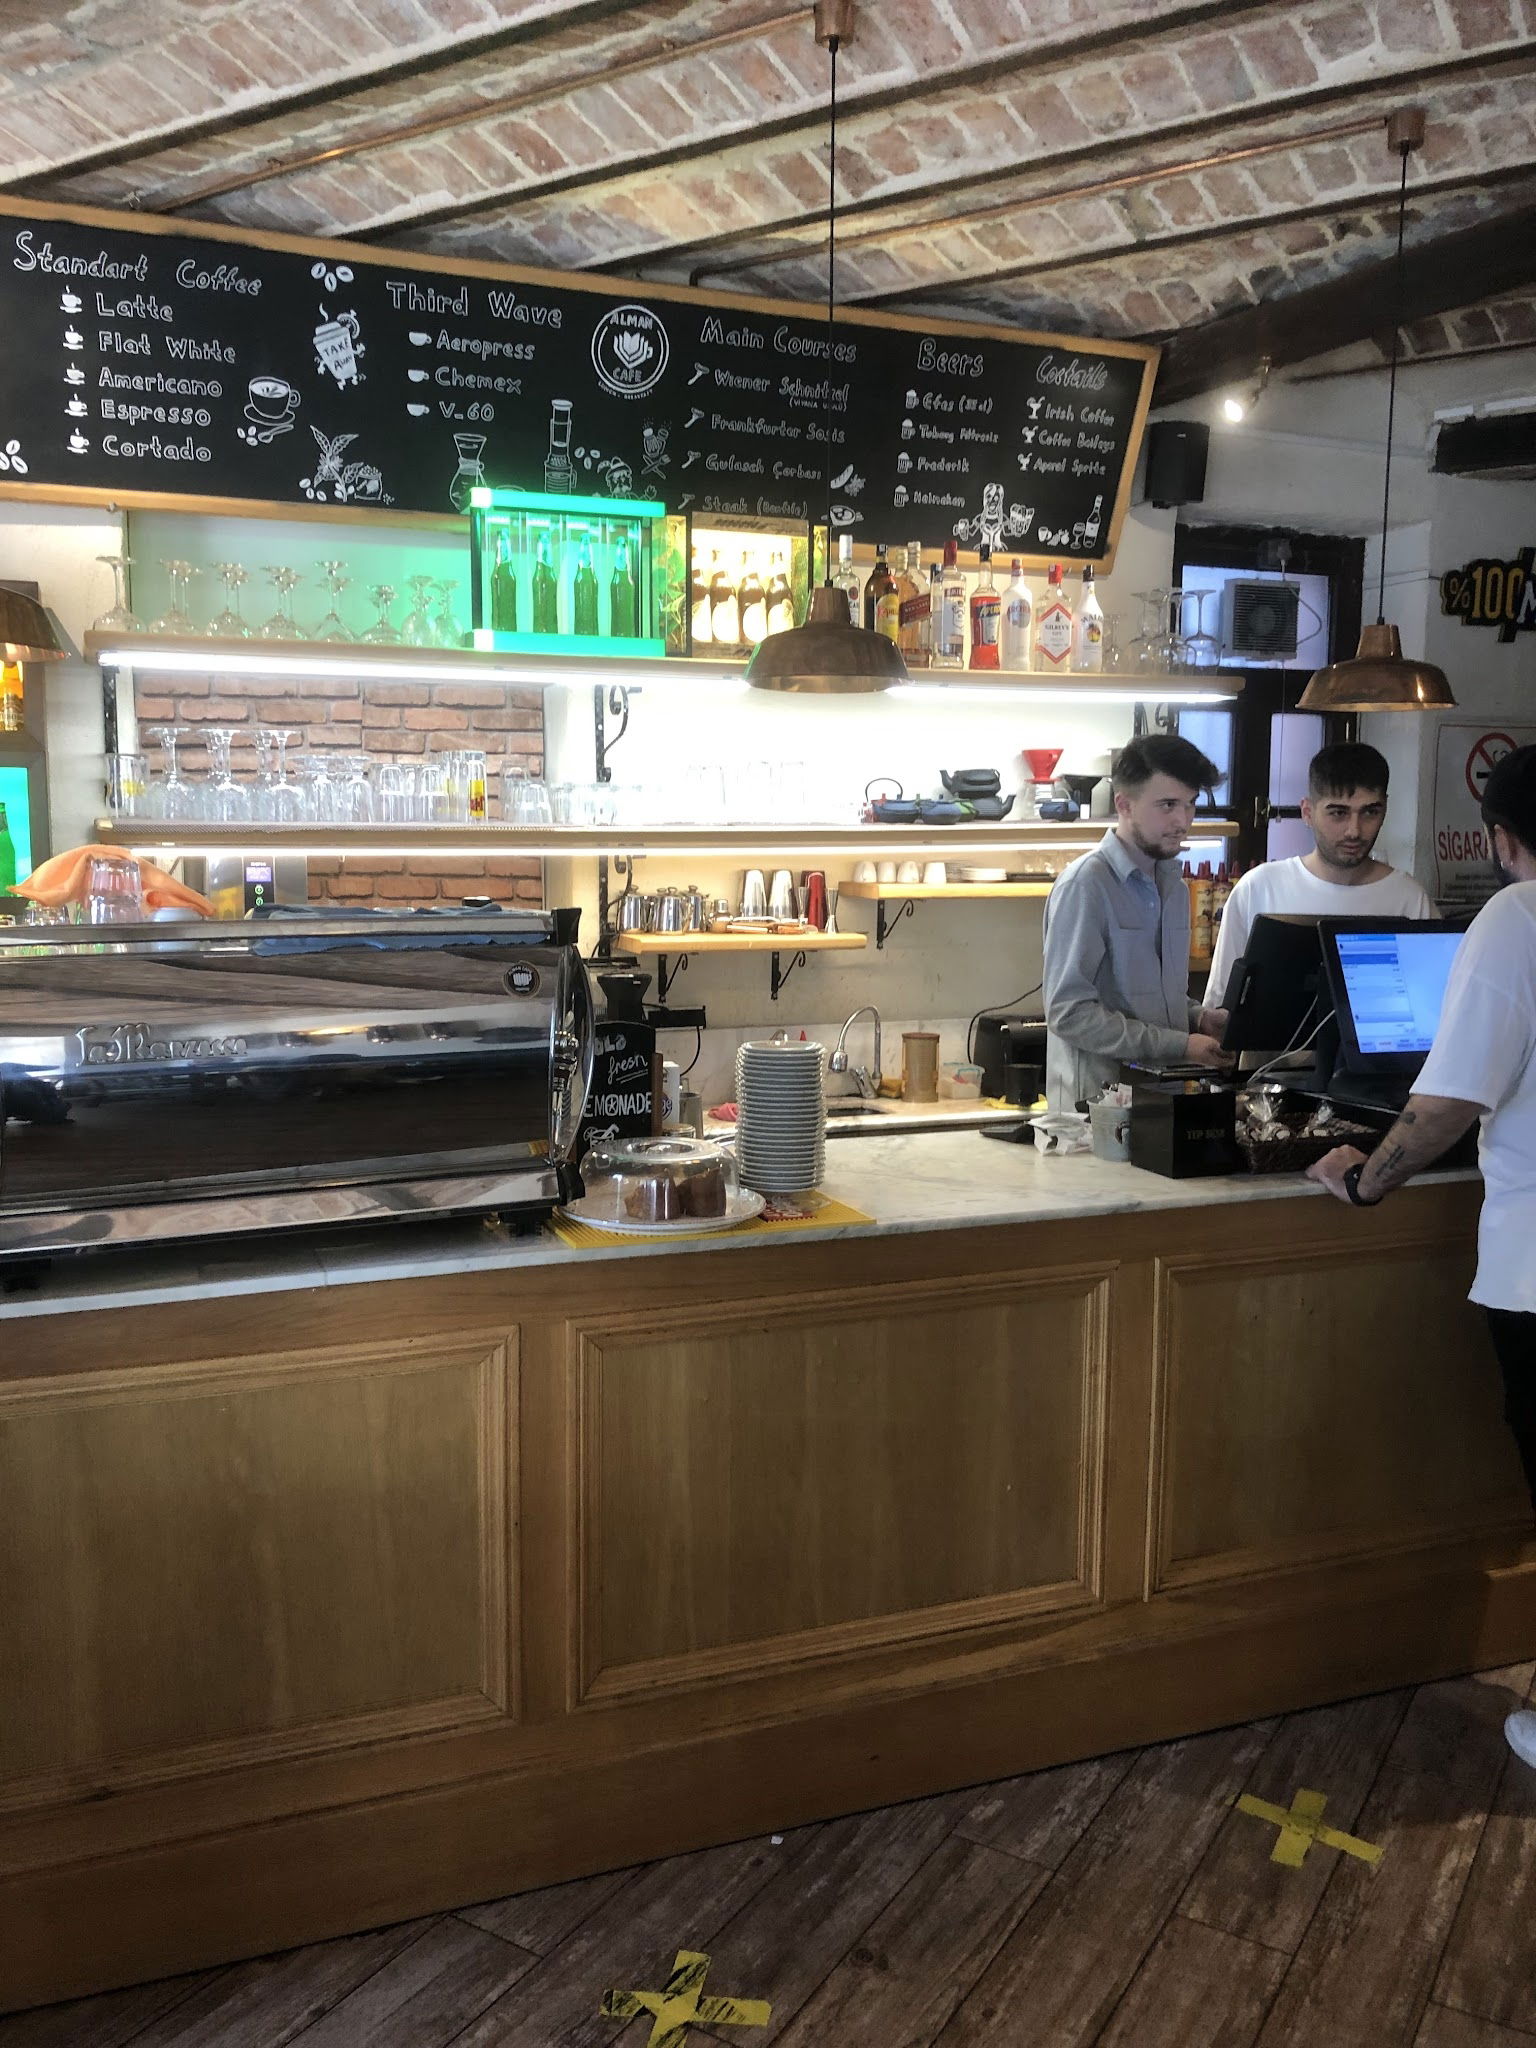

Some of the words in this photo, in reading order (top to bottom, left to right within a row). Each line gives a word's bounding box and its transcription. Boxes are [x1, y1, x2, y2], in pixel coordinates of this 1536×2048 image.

[13, 230, 148, 282] Standart
[176, 259, 262, 296] Coffee
[95, 292, 173, 322] Latte
[386, 281, 468, 316] Third
[488, 290, 563, 329] Wave
[609, 311, 653, 331] ALMAN
[98, 331, 151, 356] Flat
[165, 336, 236, 364] White
[436, 329, 536, 361] Aeropress
[700, 316, 764, 349] Main
[773, 325, 857, 362] Courses
[917, 338, 984, 378] Beers
[98, 366, 223, 398] Americano
[435, 366, 522, 394] Chemex
[613, 366, 642, 382] CAFE
[715, 369, 770, 392] Wiener
[779, 376, 850, 402] Schnitzel
[100, 399, 212, 427] Espresso
[712, 414, 801, 438] Frankfurter
[1045, 403, 1074, 422] Irish
[102, 435, 212, 462] Cortado
[705, 454, 764, 474] Gulasch
[703, 496, 748, 514] Steak
